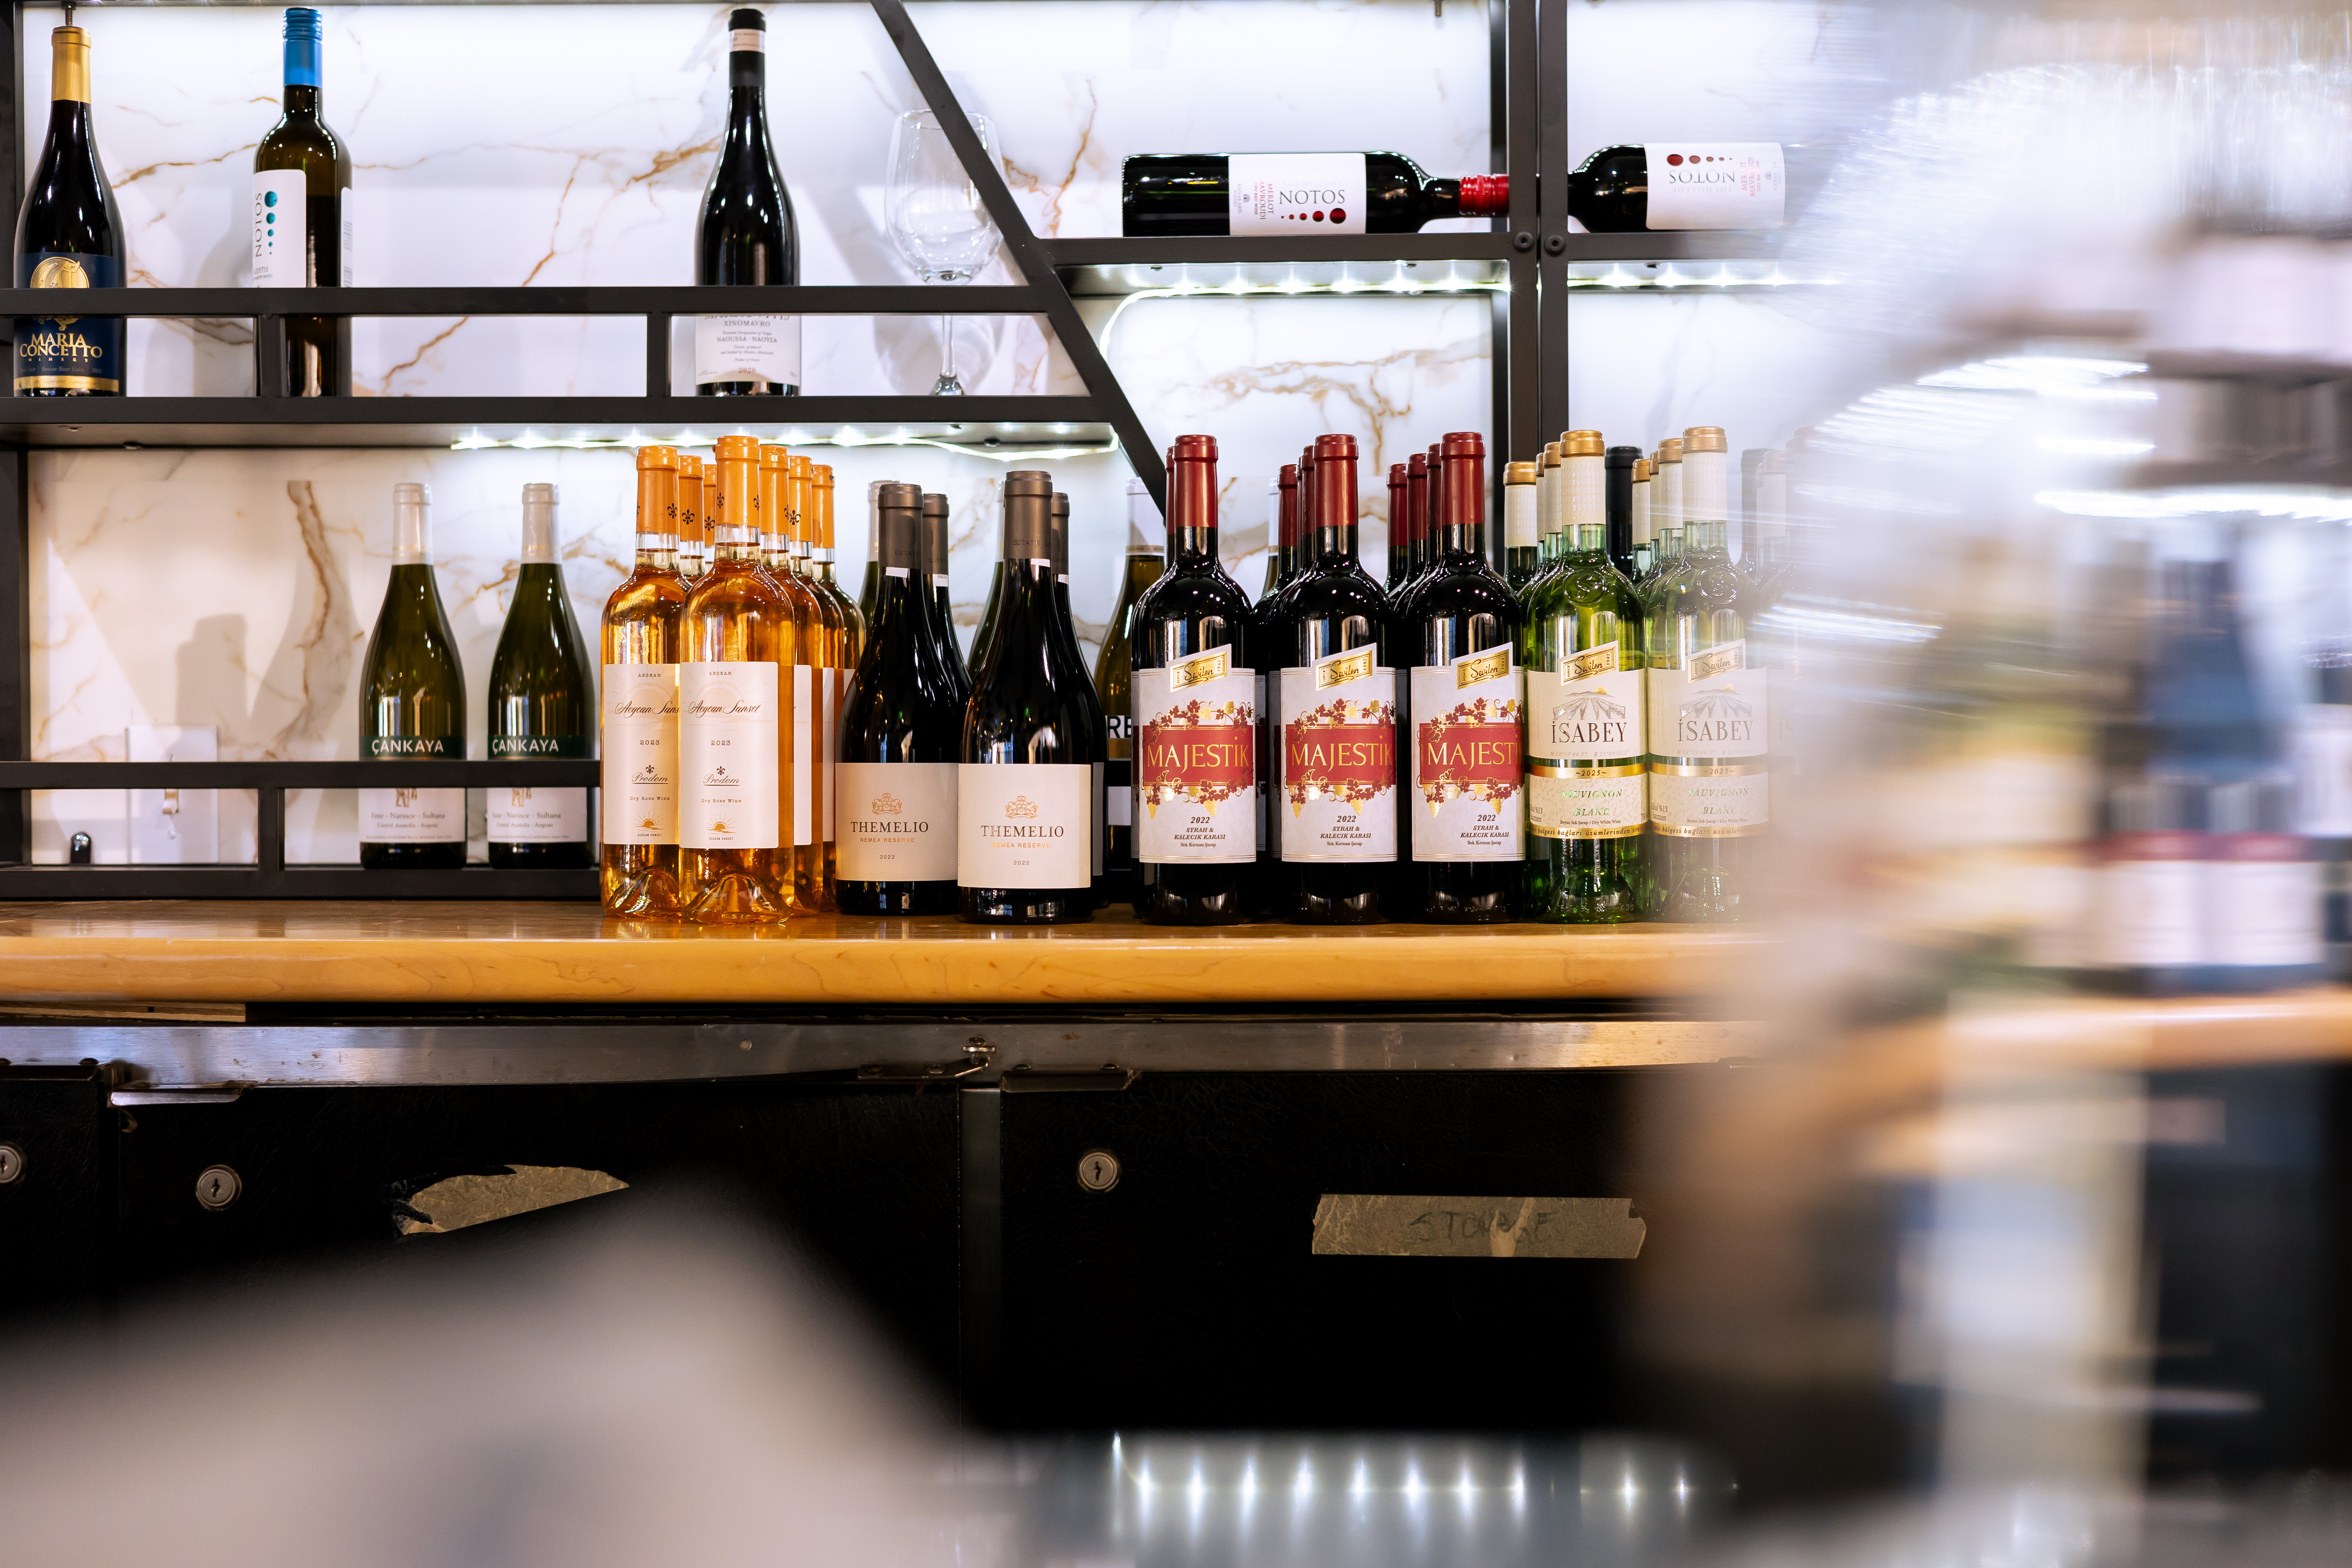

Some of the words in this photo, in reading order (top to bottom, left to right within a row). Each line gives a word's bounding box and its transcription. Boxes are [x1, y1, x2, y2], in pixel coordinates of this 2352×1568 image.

[1669, 170, 1735, 184] NOTOS
[1279, 190, 1345, 205] NOTOS
[31, 333, 87, 346] MARIA
[20, 344, 103, 358] CONCETTO
[1330, 660, 1359, 680] Sevilen
[1471, 659, 1498, 679] Sevilen
[1574, 655, 1603, 675] Sevilen
[1703, 653, 1730, 673] Sevilen
[1185, 662, 1213, 682] Sevilen
[615, 701, 652, 719] Aegean
[652, 701, 680, 715] Suns
[688, 700, 722, 718] Aegean
[722, 699, 762, 714] Sunset
[371, 739, 444, 755] ÇANKAYA
[492, 739, 559, 755] ÇANKAYA
[631, 772, 669, 782] Prodom
[703, 774, 740, 784] Prodom
[1561, 789, 1623, 798] SAUVIGNON
[1687, 787, 1749, 796] SAUVIGNON
[1703, 806, 1737, 815] BLANC
[851, 821, 929, 833] THEMELIO
[981, 825, 1064, 837] THEMELIO
